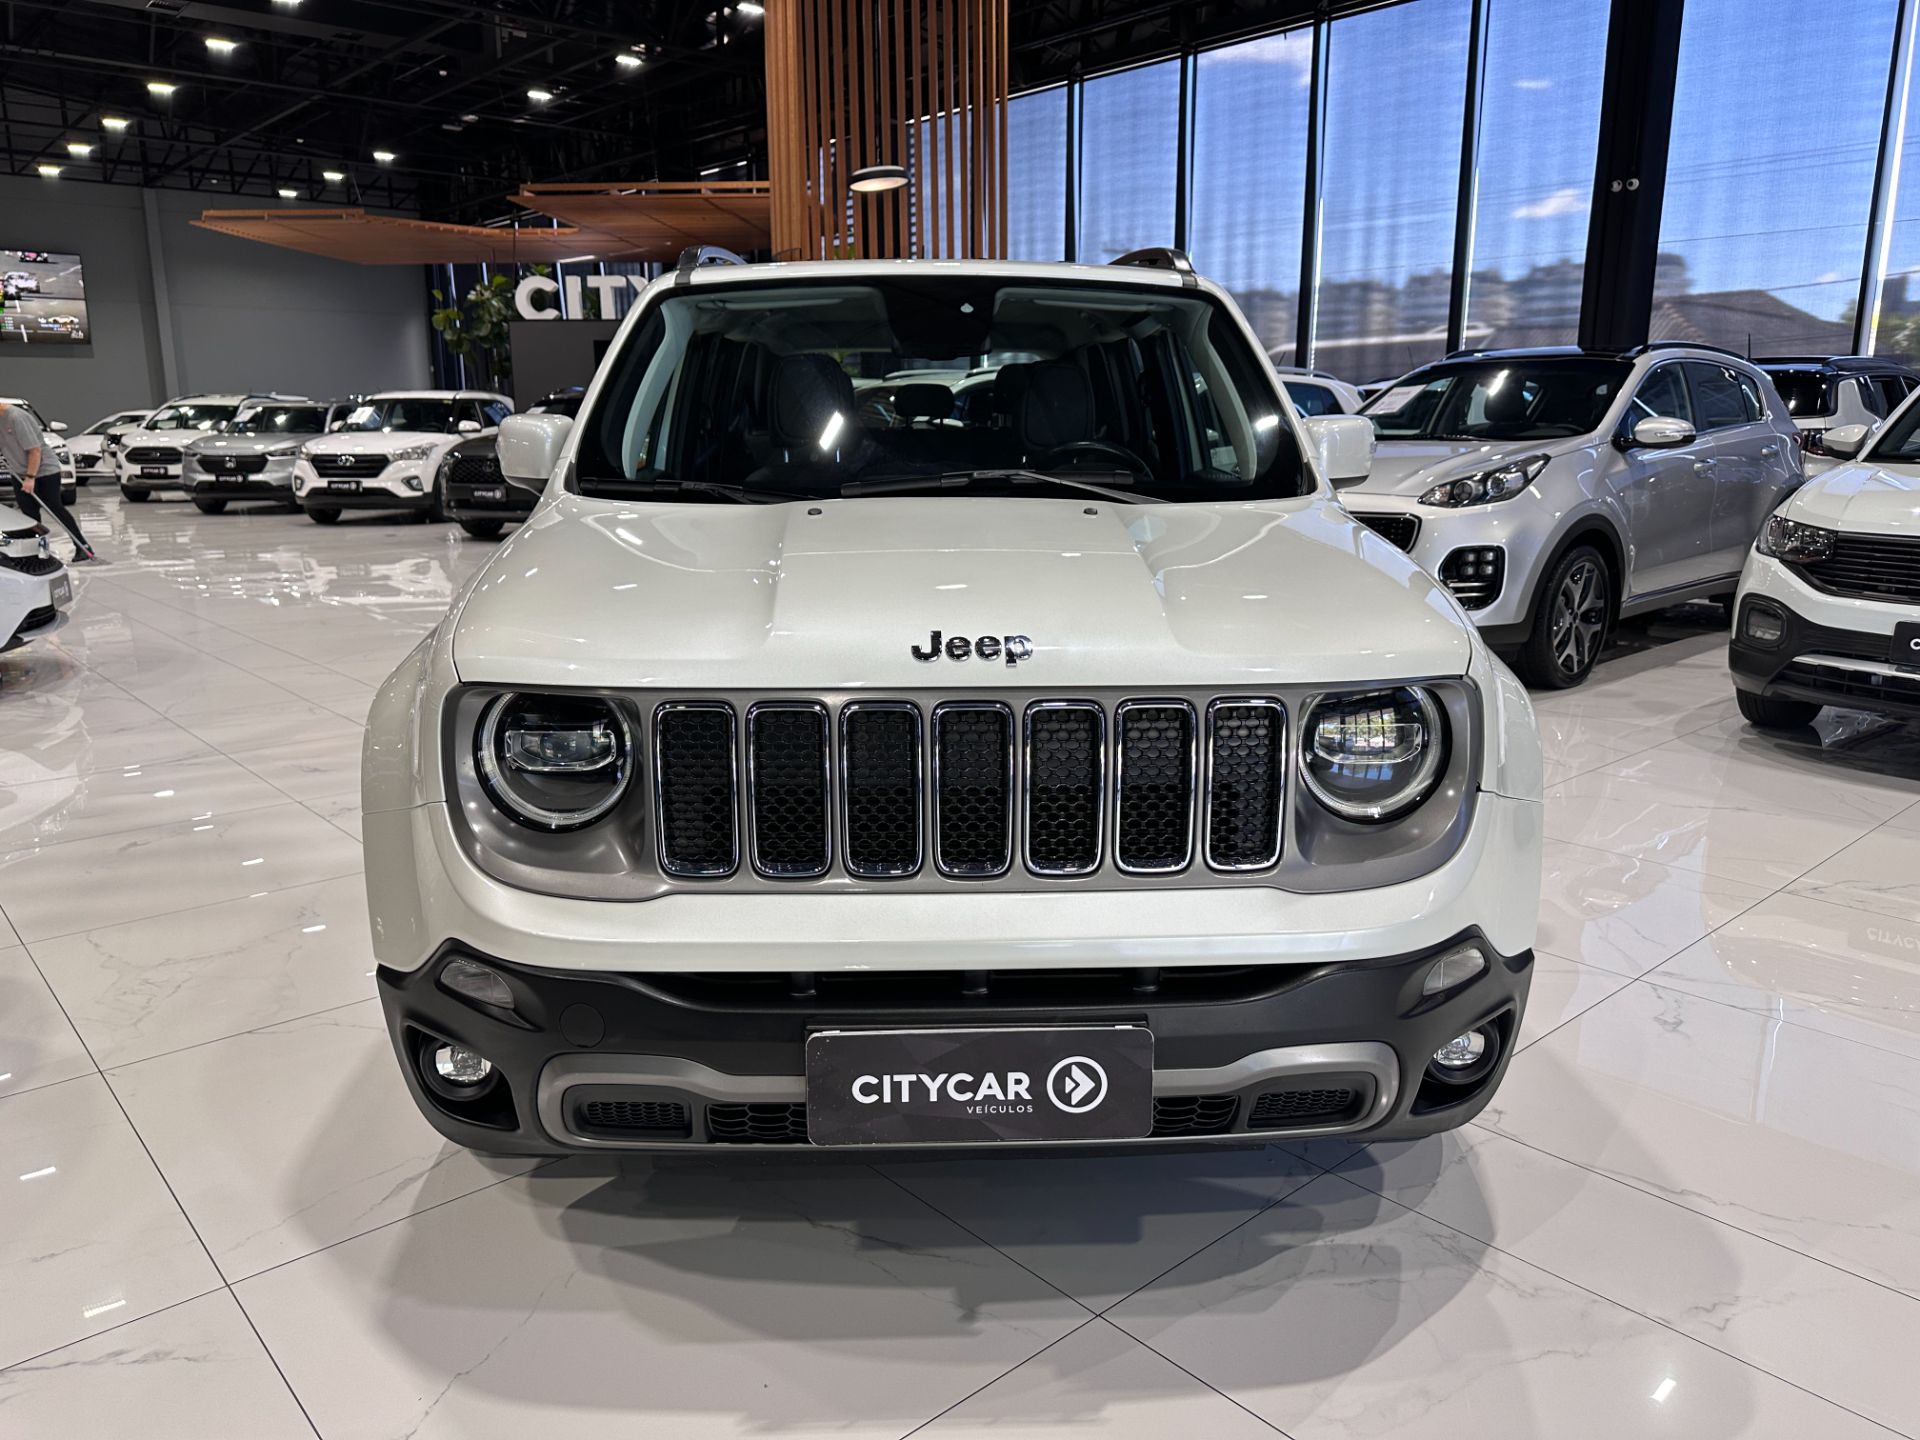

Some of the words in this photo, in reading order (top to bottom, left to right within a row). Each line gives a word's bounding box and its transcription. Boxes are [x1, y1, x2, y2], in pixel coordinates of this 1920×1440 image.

[911, 630, 1033, 668] Jeep
[851, 1071, 1033, 1104] CITYCAR
[966, 1104, 1034, 1114] VEÍCULOS
